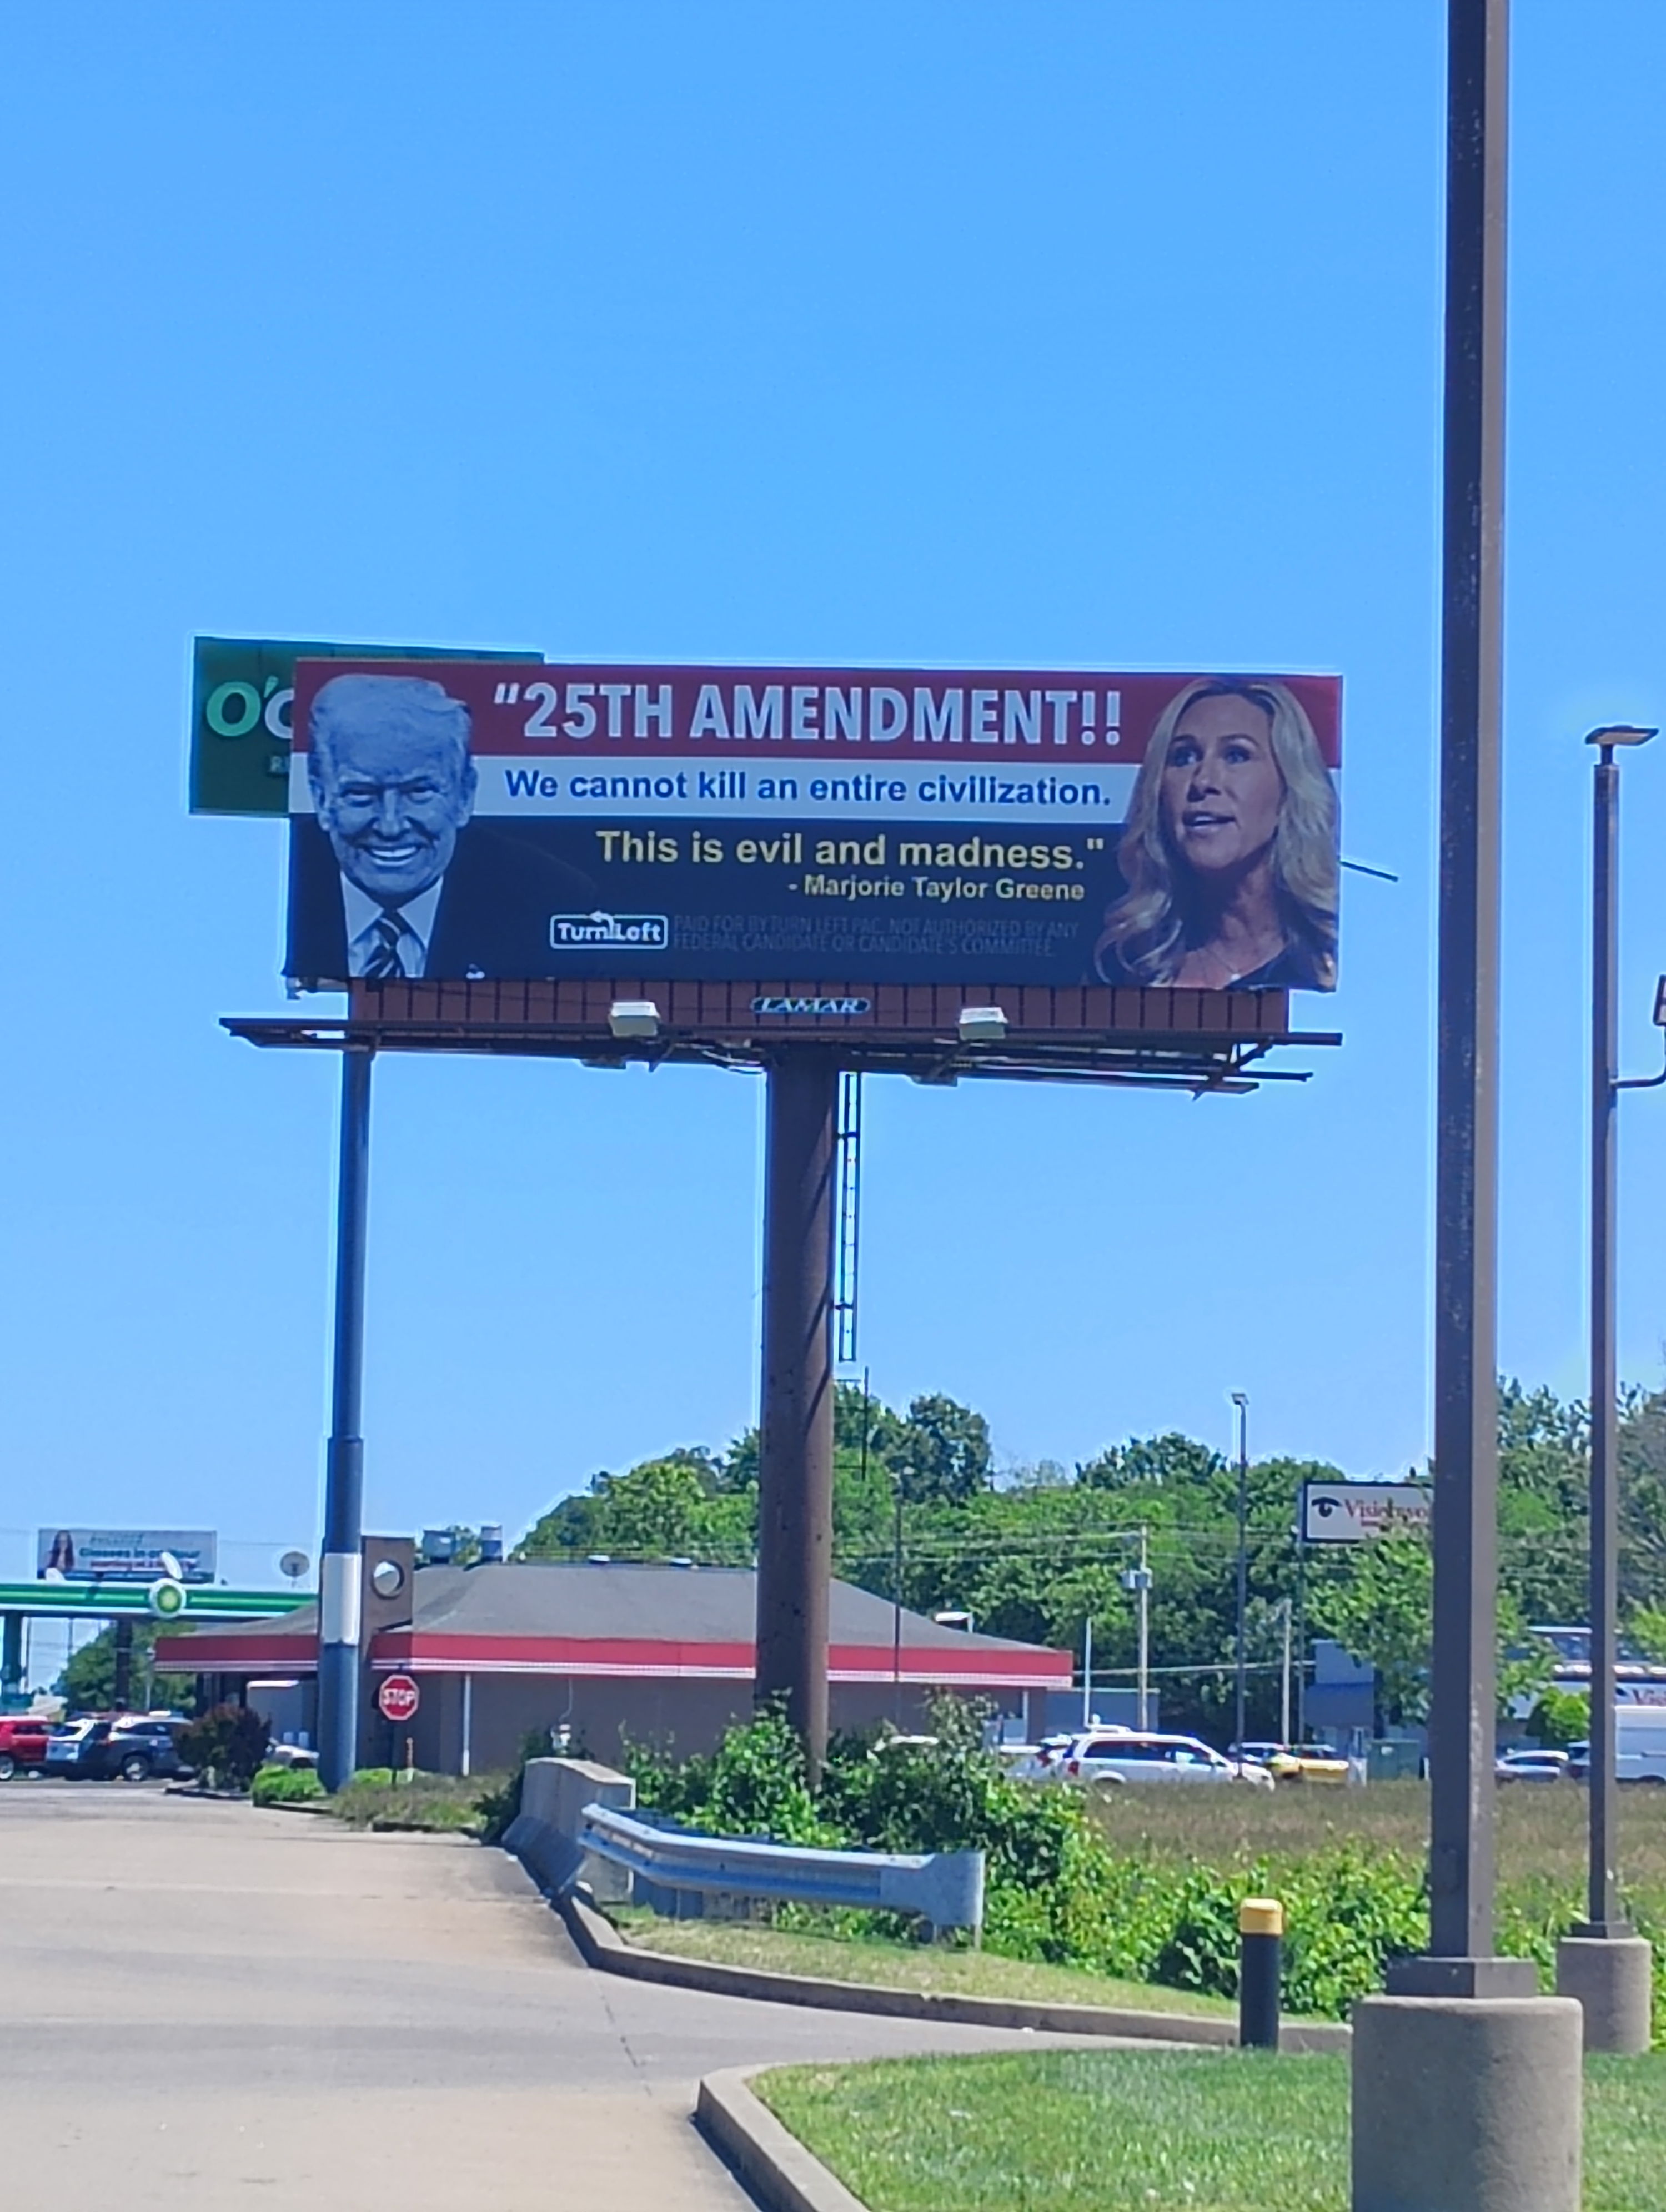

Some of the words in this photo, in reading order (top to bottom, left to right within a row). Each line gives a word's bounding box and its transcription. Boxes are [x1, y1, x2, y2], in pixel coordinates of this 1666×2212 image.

[494, 683, 673, 738] "25TH
[689, 685, 1120, 746] AMENDMENT!!
[505, 769, 558, 798] We
[570, 771, 688, 799] cannot
[699, 771, 746, 800] kill
[758, 778, 797, 801] an
[810, 773, 907, 802] entire
[919, 775, 1110, 805] civilization.
[595, 830, 679, 863] This
[692, 830, 724, 863] is
[736, 832, 802, 864] evil
[815, 833, 886, 866] and
[899, 835, 1105, 869] madness."
[804, 874, 905, 902] Marjorie
[911, 876, 989, 903] Taylor
[995, 877, 1085, 901] Greene
[674, 914, 710, 932] PAID
[713, 914, 745, 933] FOR
[815, 916, 848, 934] LEFT
[889, 917, 920, 936] NOT
[922, 918, 1021, 938] AUTHORIZED
[1047, 920, 1080, 939] ANY
[674, 933, 740, 952] FEDERAL
[741, 933, 827, 953] CANDIDATE
[831, 934, 856, 953] OR
[761, 998, 859, 1013] LAMAR
[383, 1688, 415, 1706] STOP
